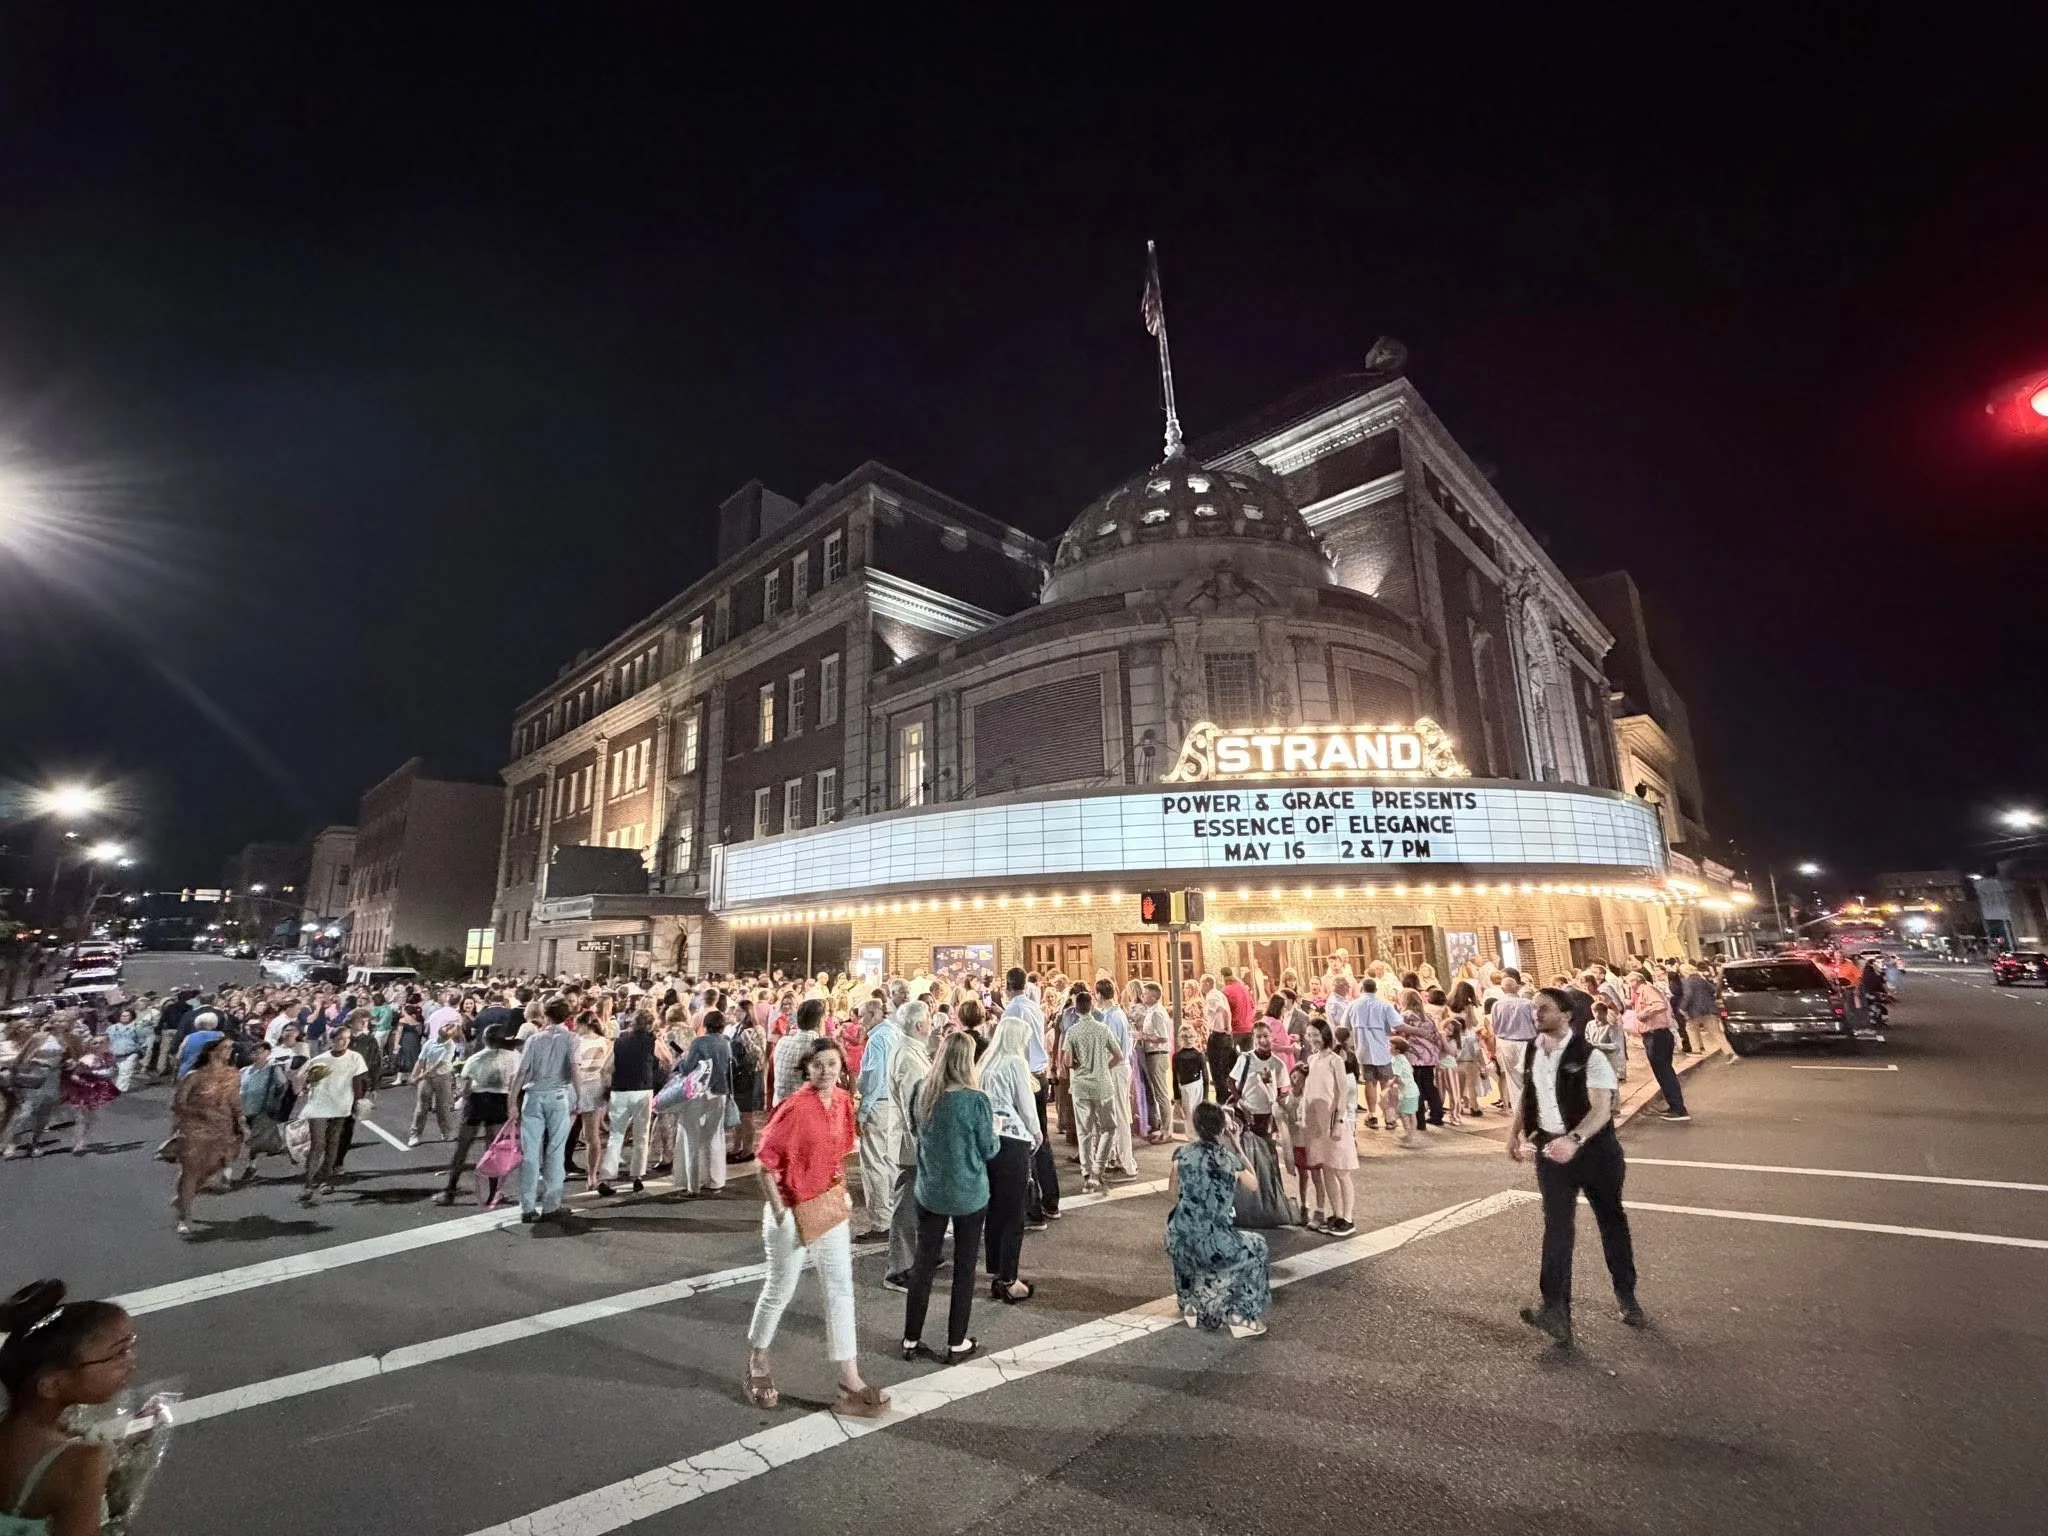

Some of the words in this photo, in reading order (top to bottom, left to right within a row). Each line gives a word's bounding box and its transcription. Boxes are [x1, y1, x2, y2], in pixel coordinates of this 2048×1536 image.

[1216, 734, 1422, 772] STRAND
[1164, 794, 1241, 815] POWER
[1255, 793, 1270, 811] &
[1282, 791, 1355, 810] GRACE
[1372, 791, 1477, 810] PRESENTS
[1193, 817, 1295, 838] ESSENCE
[1305, 815, 1334, 834] OF
[1349, 815, 1454, 834] ELEGANCE
[1224, 842, 1271, 861] MAY
[1284, 841, 1306, 859] 16
[1340, 840, 1355, 858] 2
[1360, 840, 1375, 858] &
[1381, 839, 1394, 858] 7
[1402, 839, 1431, 858] PM
